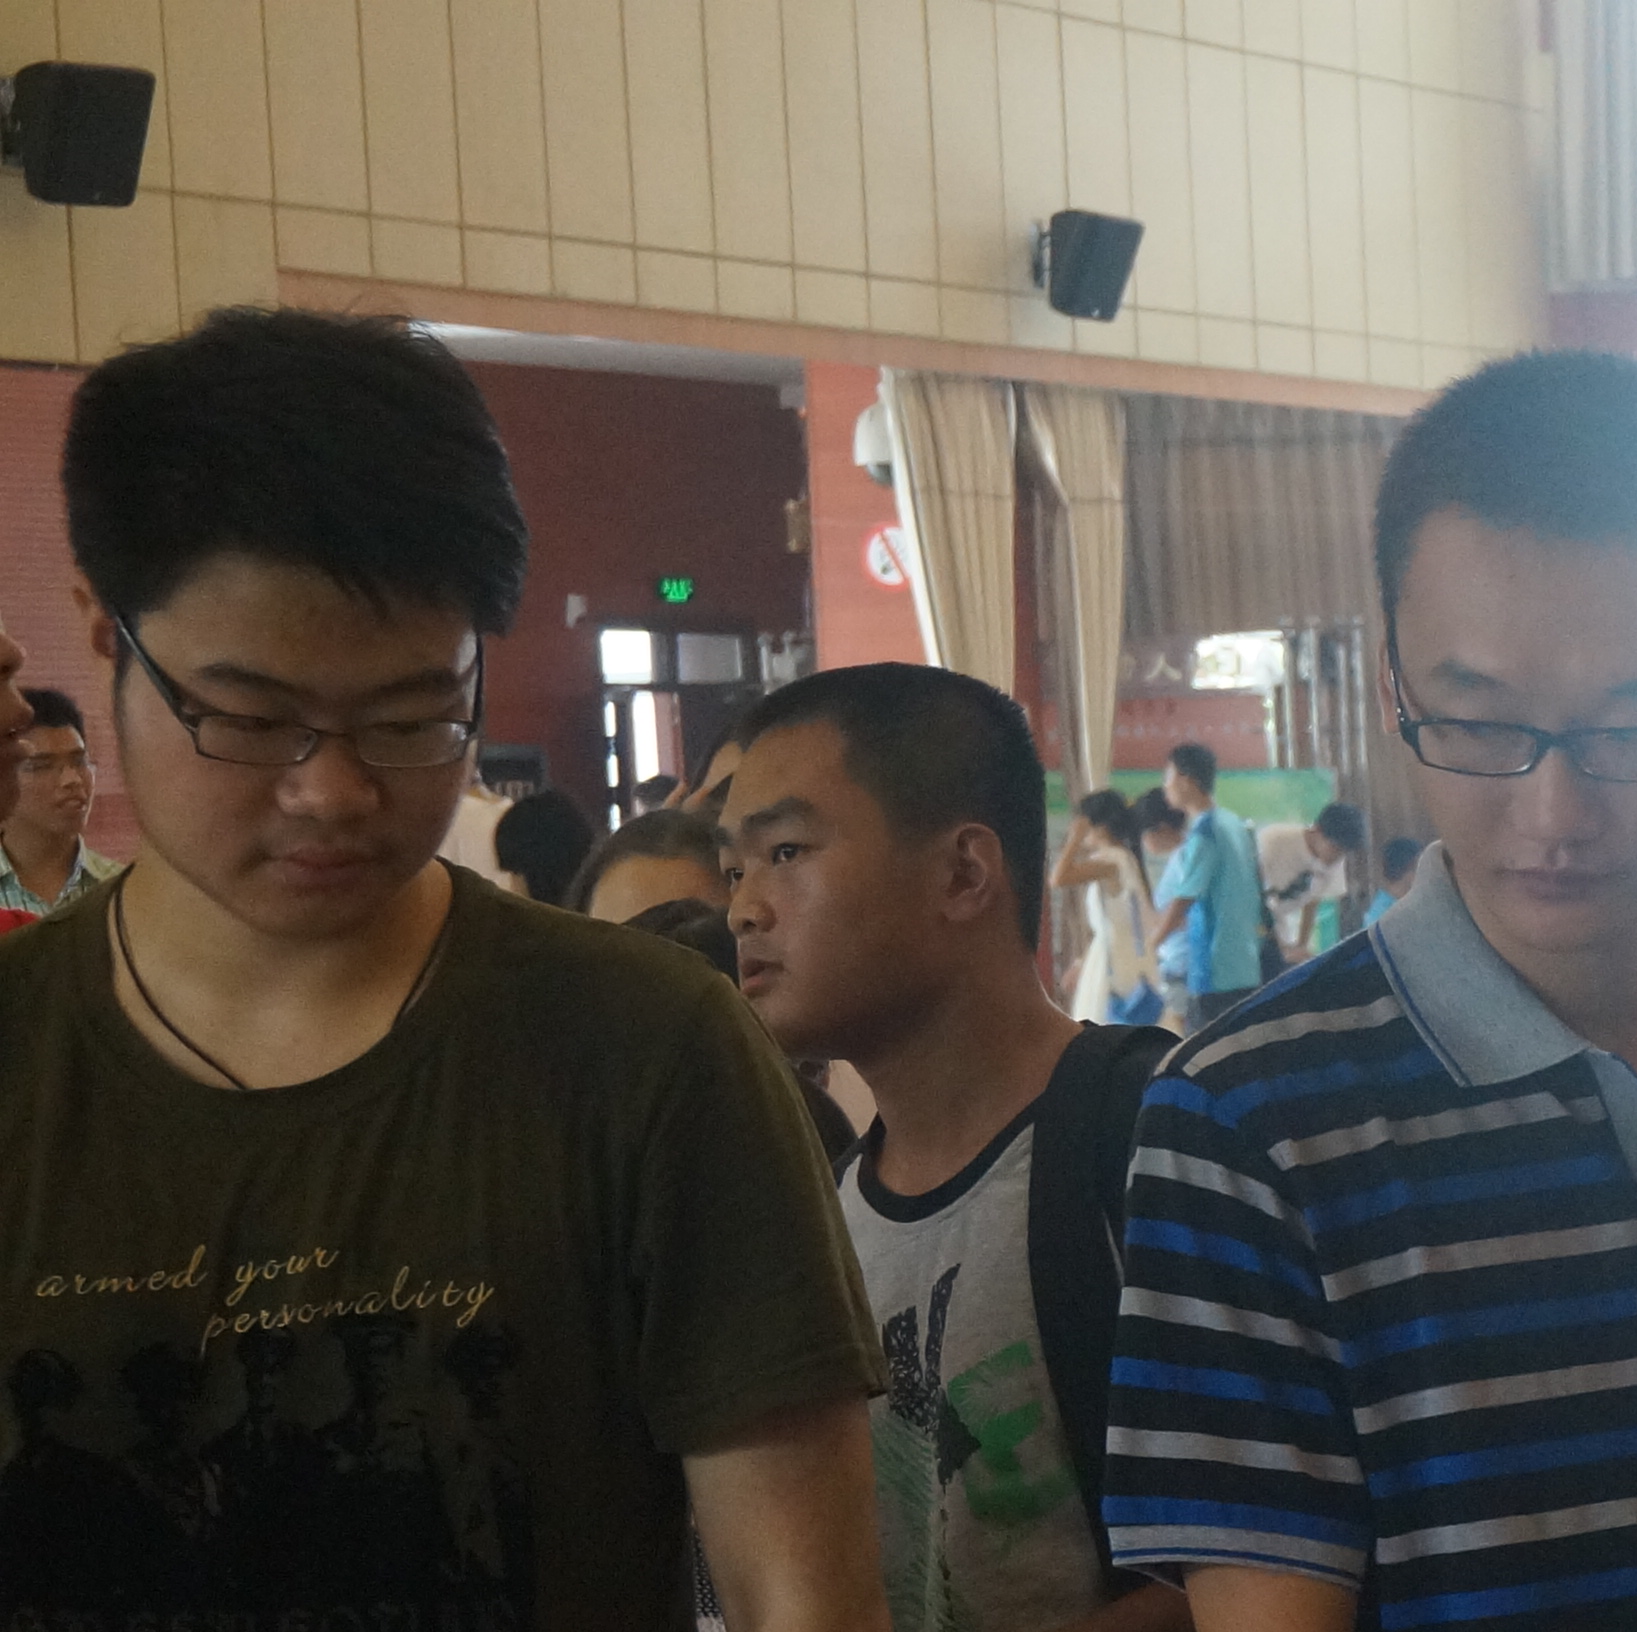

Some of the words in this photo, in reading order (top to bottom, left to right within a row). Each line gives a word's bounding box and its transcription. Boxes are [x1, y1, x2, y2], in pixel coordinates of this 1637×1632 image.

[36, 1244, 208, 1298] armed
[226, 1246, 340, 1307] your
[200, 1265, 497, 1360] personality
